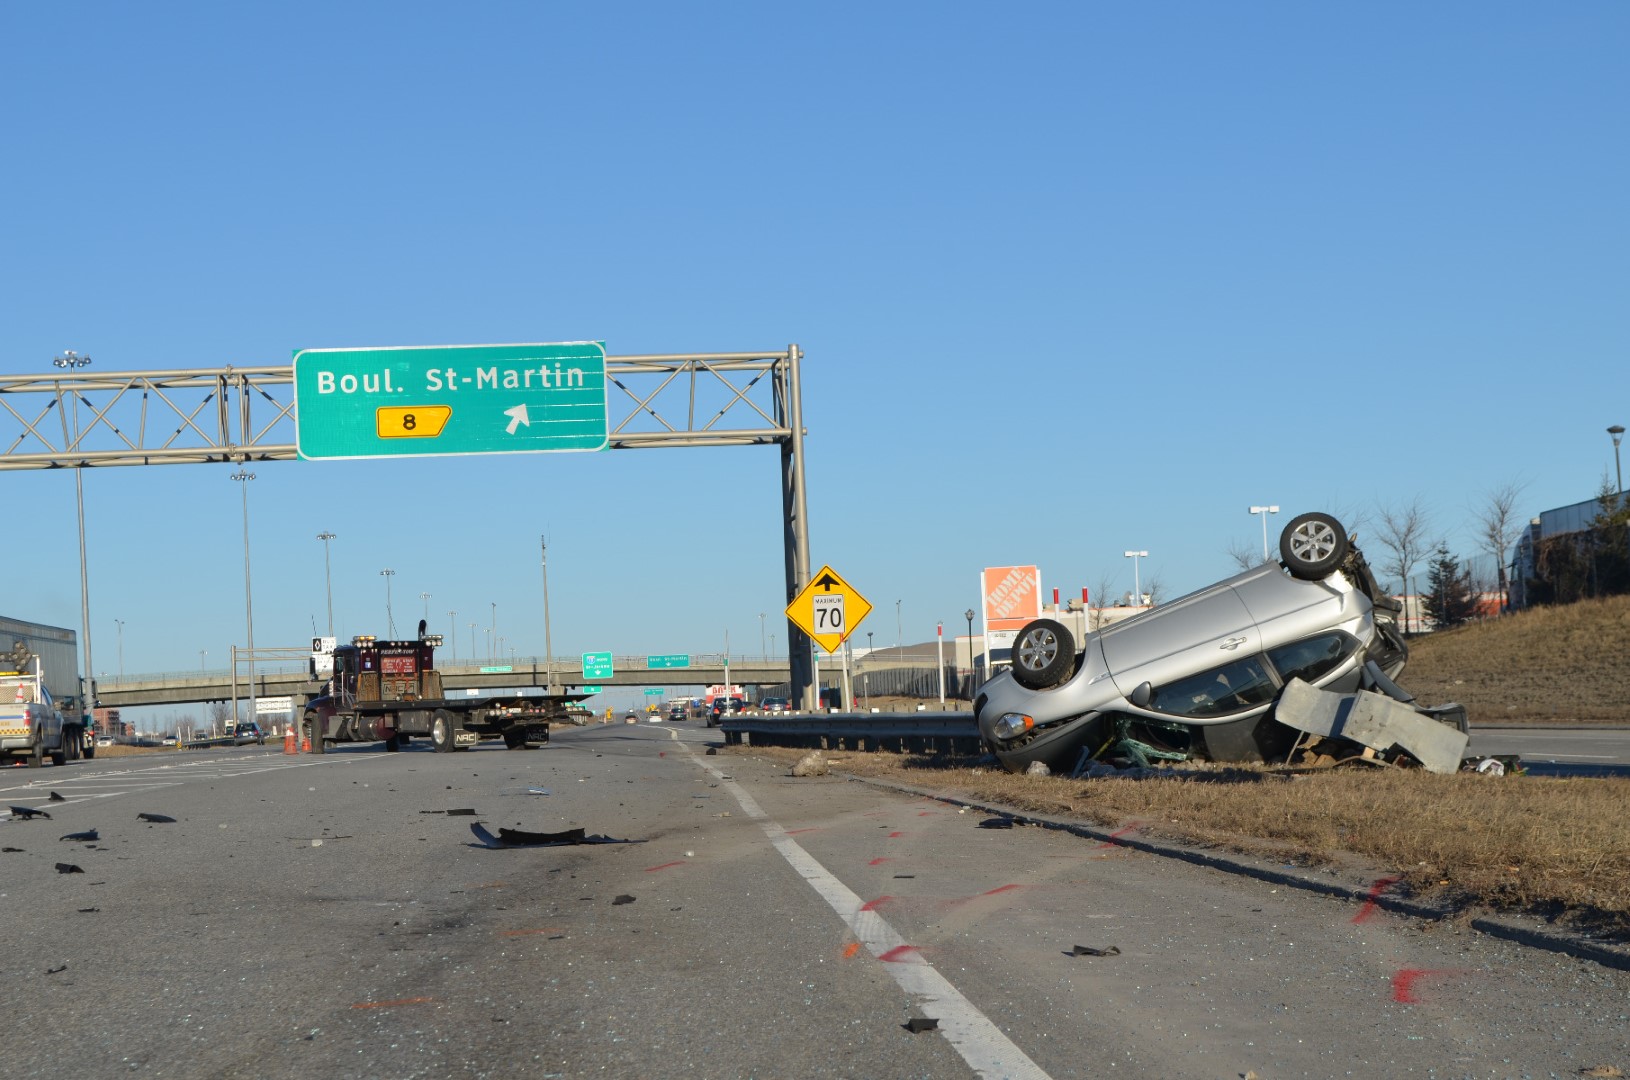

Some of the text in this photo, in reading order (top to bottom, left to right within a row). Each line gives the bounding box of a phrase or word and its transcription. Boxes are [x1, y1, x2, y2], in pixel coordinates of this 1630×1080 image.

[317, 362, 584, 395] Boul. St-Martin
[402, 413, 417, 431] 8
[986, 567, 1025, 608] HOME
[995, 572, 1036, 618] DEPOT
[816, 608, 842, 628] 70
